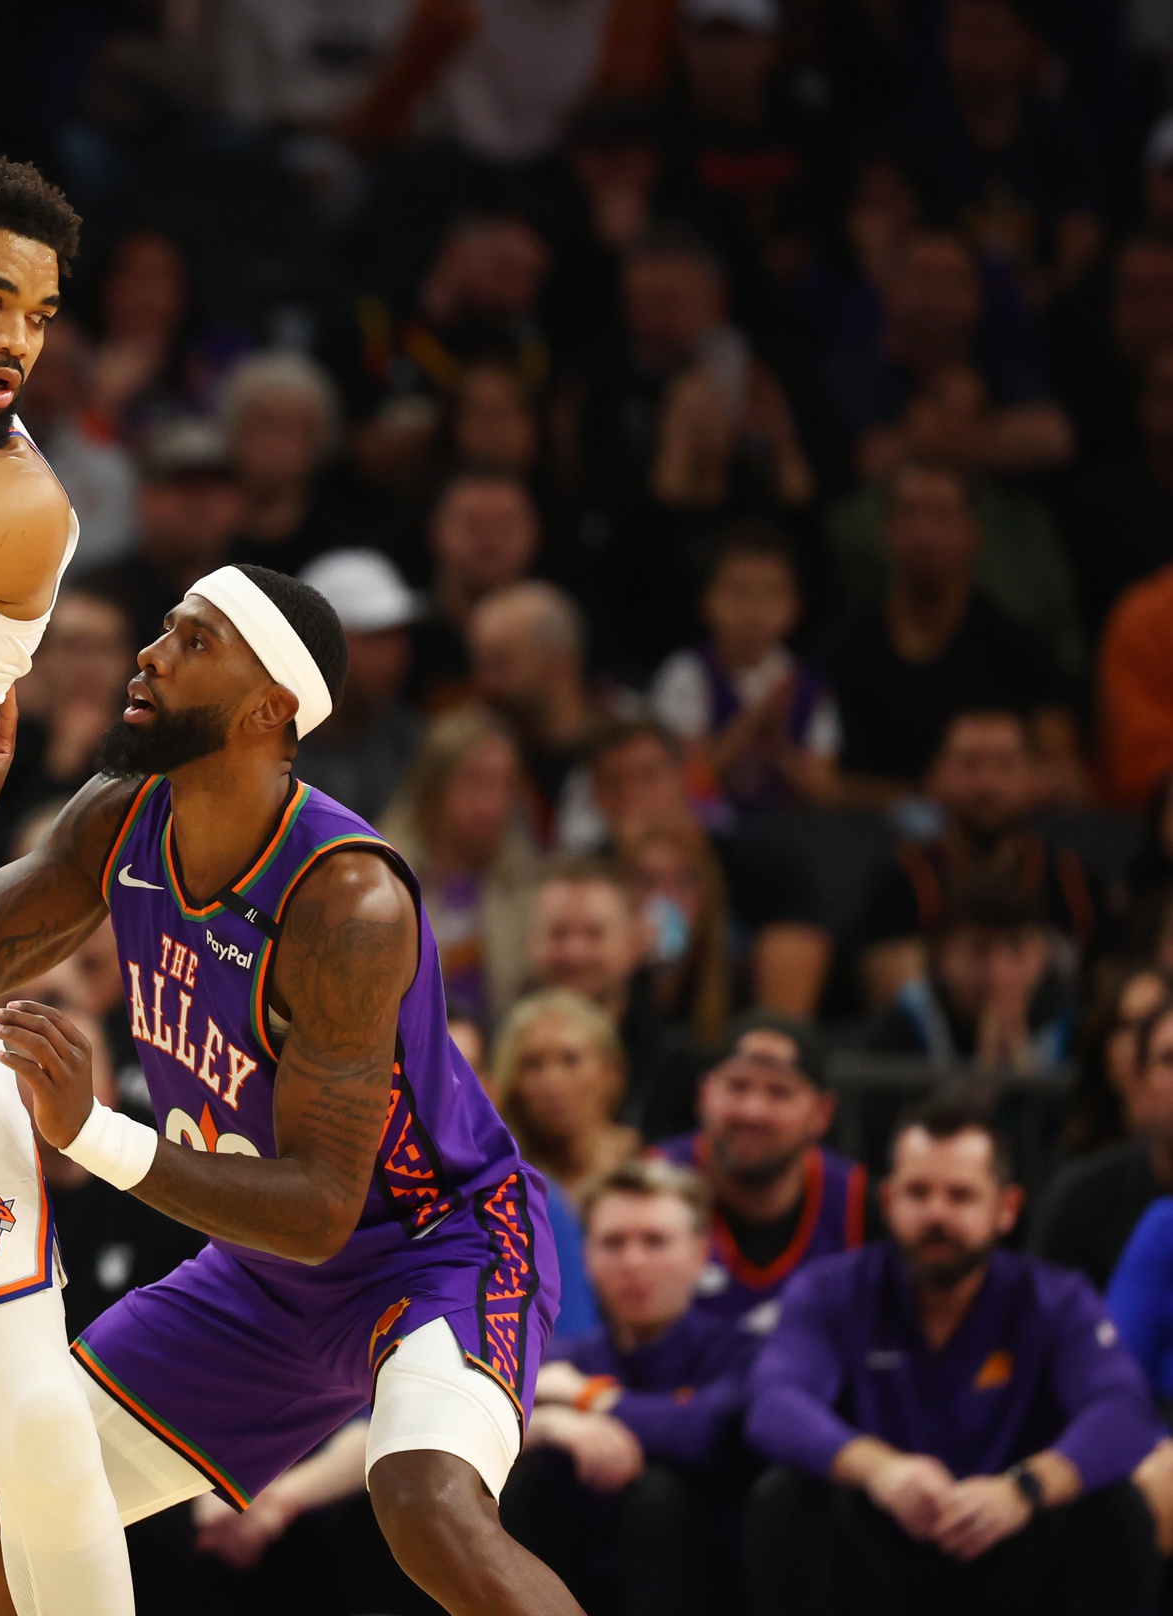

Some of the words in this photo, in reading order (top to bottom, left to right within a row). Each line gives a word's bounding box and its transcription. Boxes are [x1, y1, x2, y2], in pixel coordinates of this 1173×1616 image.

[244, 907, 258, 924] AL
[161, 932, 199, 990] THE
[206, 928, 254, 970] PayPal
[127, 959, 259, 1112] ALLEY
